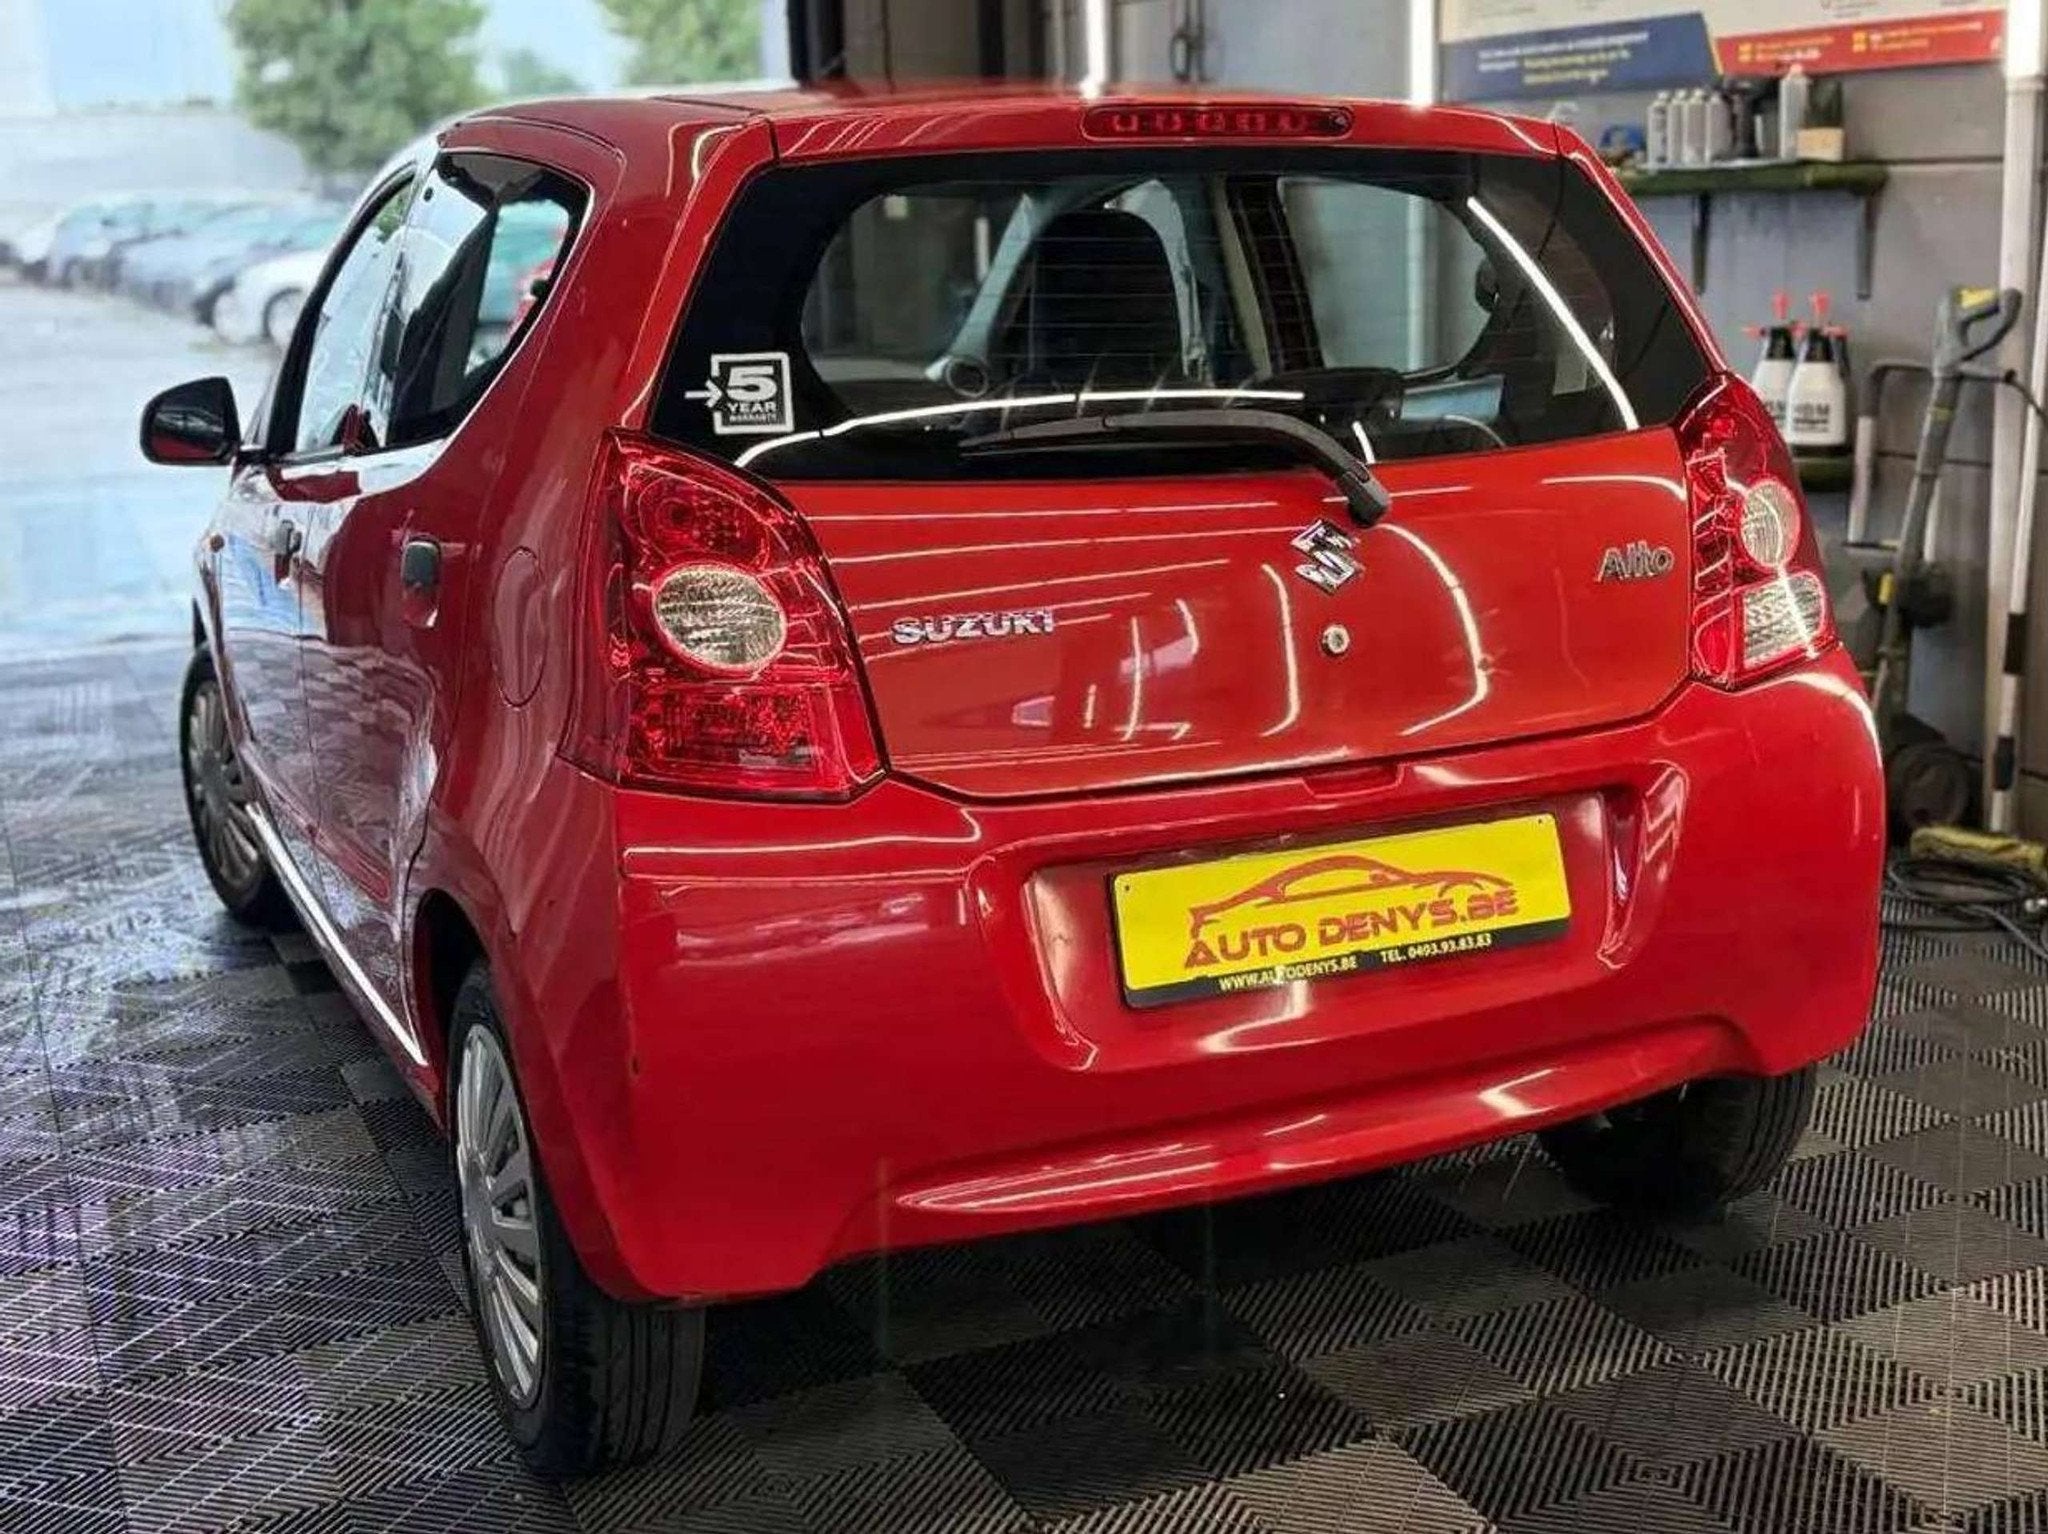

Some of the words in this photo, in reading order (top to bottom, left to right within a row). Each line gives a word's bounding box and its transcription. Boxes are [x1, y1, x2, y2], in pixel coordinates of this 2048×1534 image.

[726, 365, 778, 402] 5
[727, 401, 777, 413] YEAR
[1596, 540, 1675, 583] Alto
[892, 610, 1054, 644] SUZUKI
[1184, 922, 1307, 969] AUTO
[1318, 887, 1520, 947] DENYS.BE
[1218, 956, 1357, 991] WWW.AUTODENYS.BE
[1380, 950, 1407, 963] TEL.
